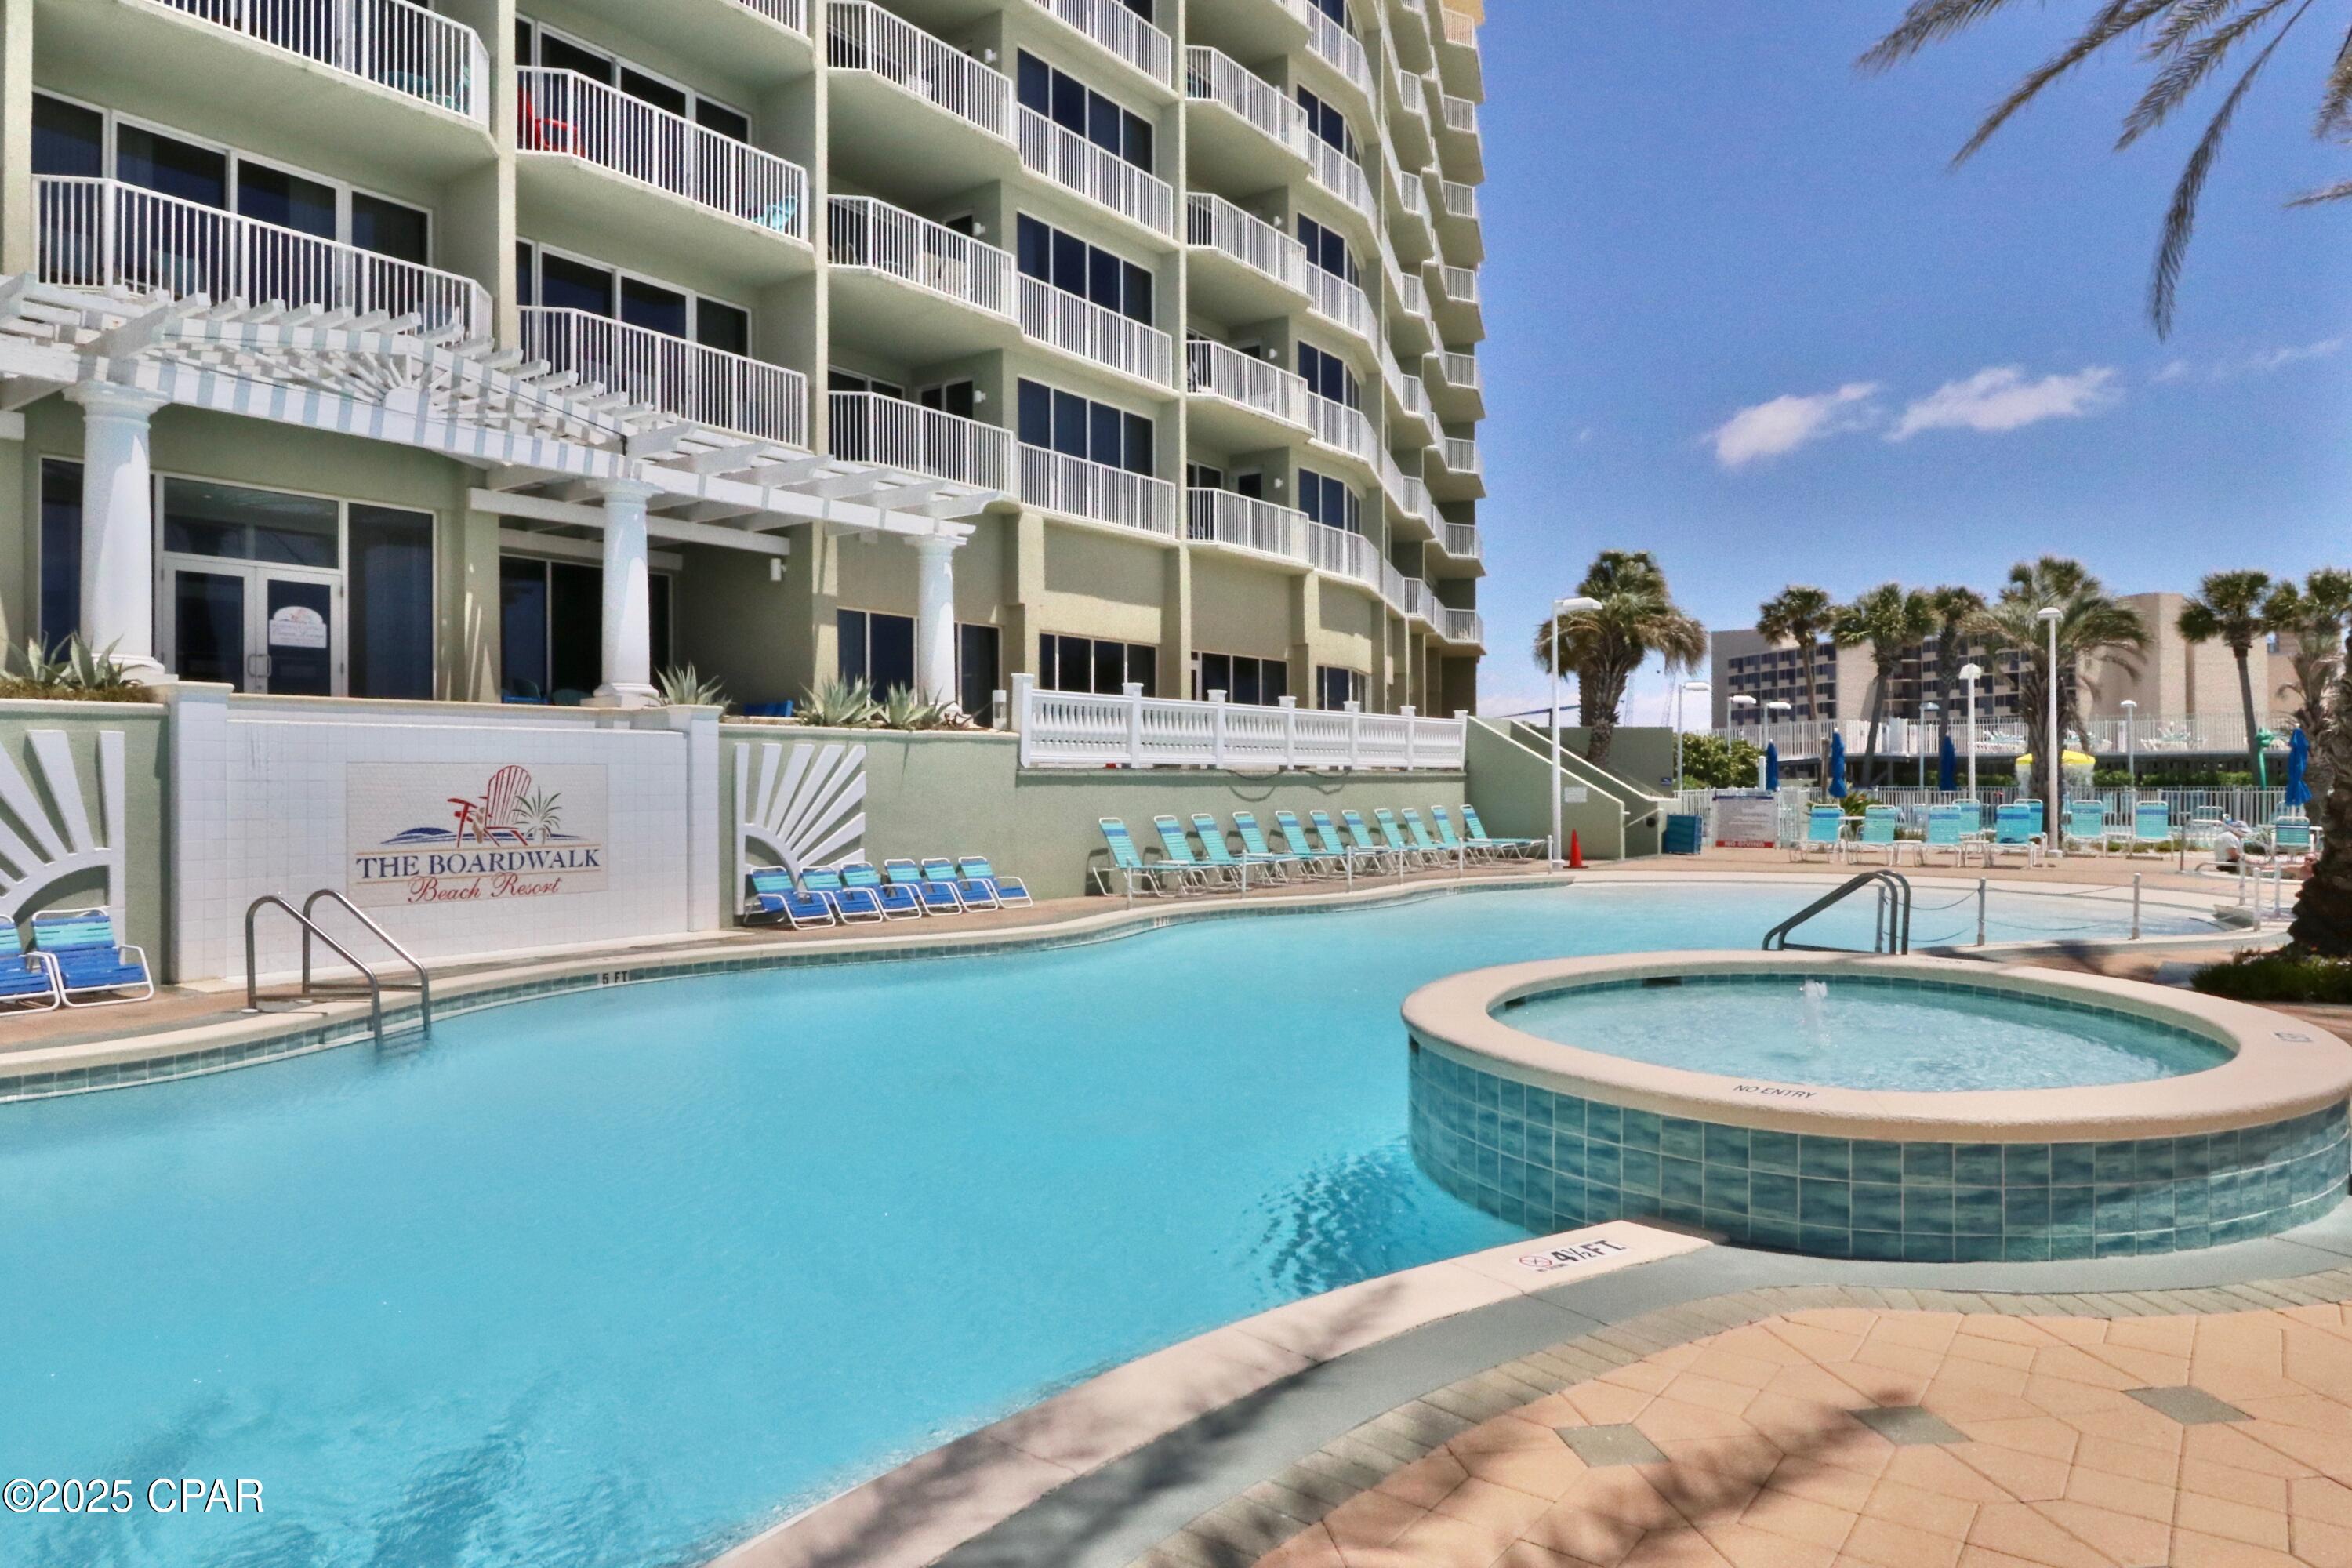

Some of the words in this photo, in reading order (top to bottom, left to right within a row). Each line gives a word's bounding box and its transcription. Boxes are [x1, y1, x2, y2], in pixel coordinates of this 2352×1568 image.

[356, 855, 419, 879] THE
[429, 849, 600, 875] BOARDWALK
[407, 875, 481, 902] Beach
[490, 873, 561, 898] Resort
[602, 973, 609, 985] 5
[615, 971, 628, 983] FT
[1762, 1088, 1817, 1098] ENTRY
